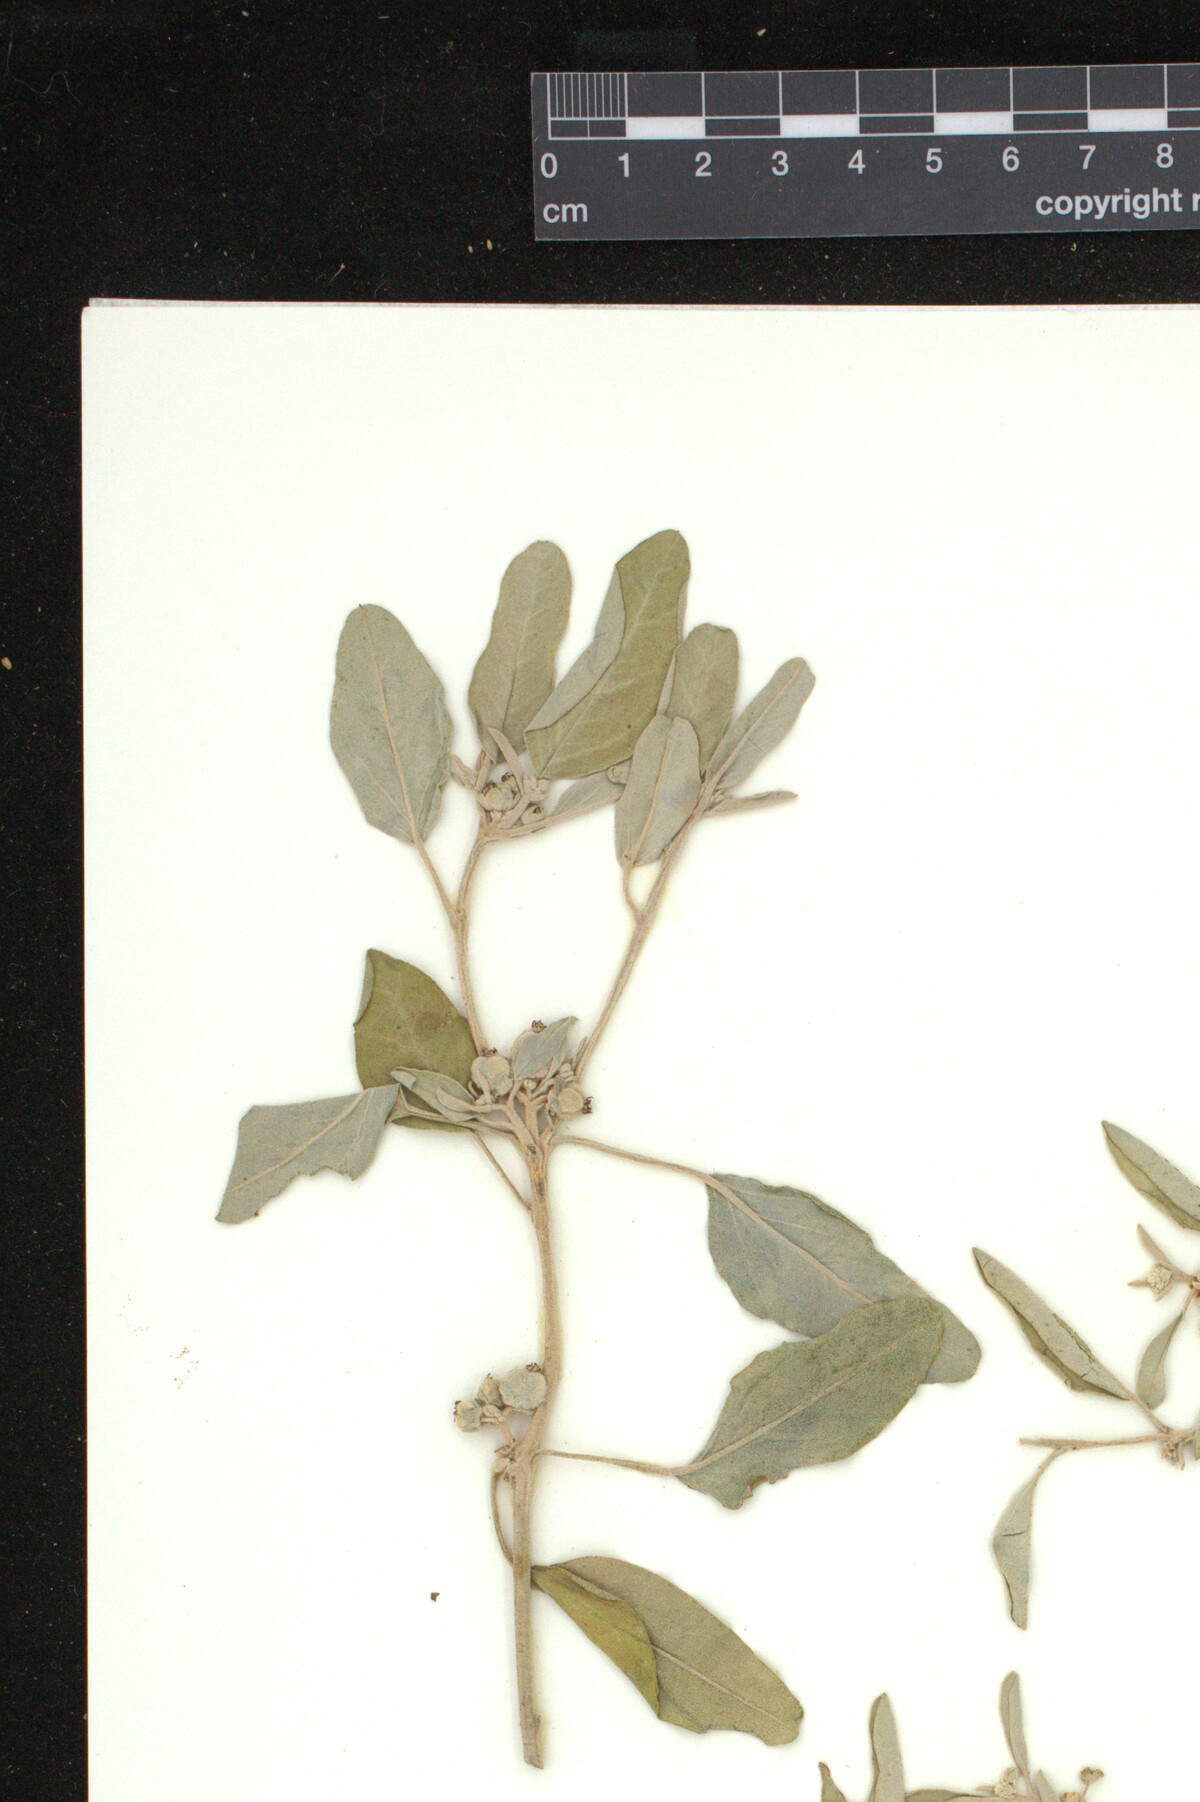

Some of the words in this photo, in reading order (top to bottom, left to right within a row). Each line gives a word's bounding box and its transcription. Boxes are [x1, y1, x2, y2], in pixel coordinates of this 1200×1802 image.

[540, 153, 558, 179] 0
[618, 153, 630, 177] 1
[695, 152, 712, 177] 2
[771, 150, 789, 176] 3
[848, 150, 866, 174] 4
[925, 148, 943, 173] 5
[1002, 146, 1020, 172] 6
[1079, 145, 1096, 170] 7
[1156, 143, 1174, 168] 8
[542, 202, 588, 223] cm
[1035, 187, 1183, 221] copyright
